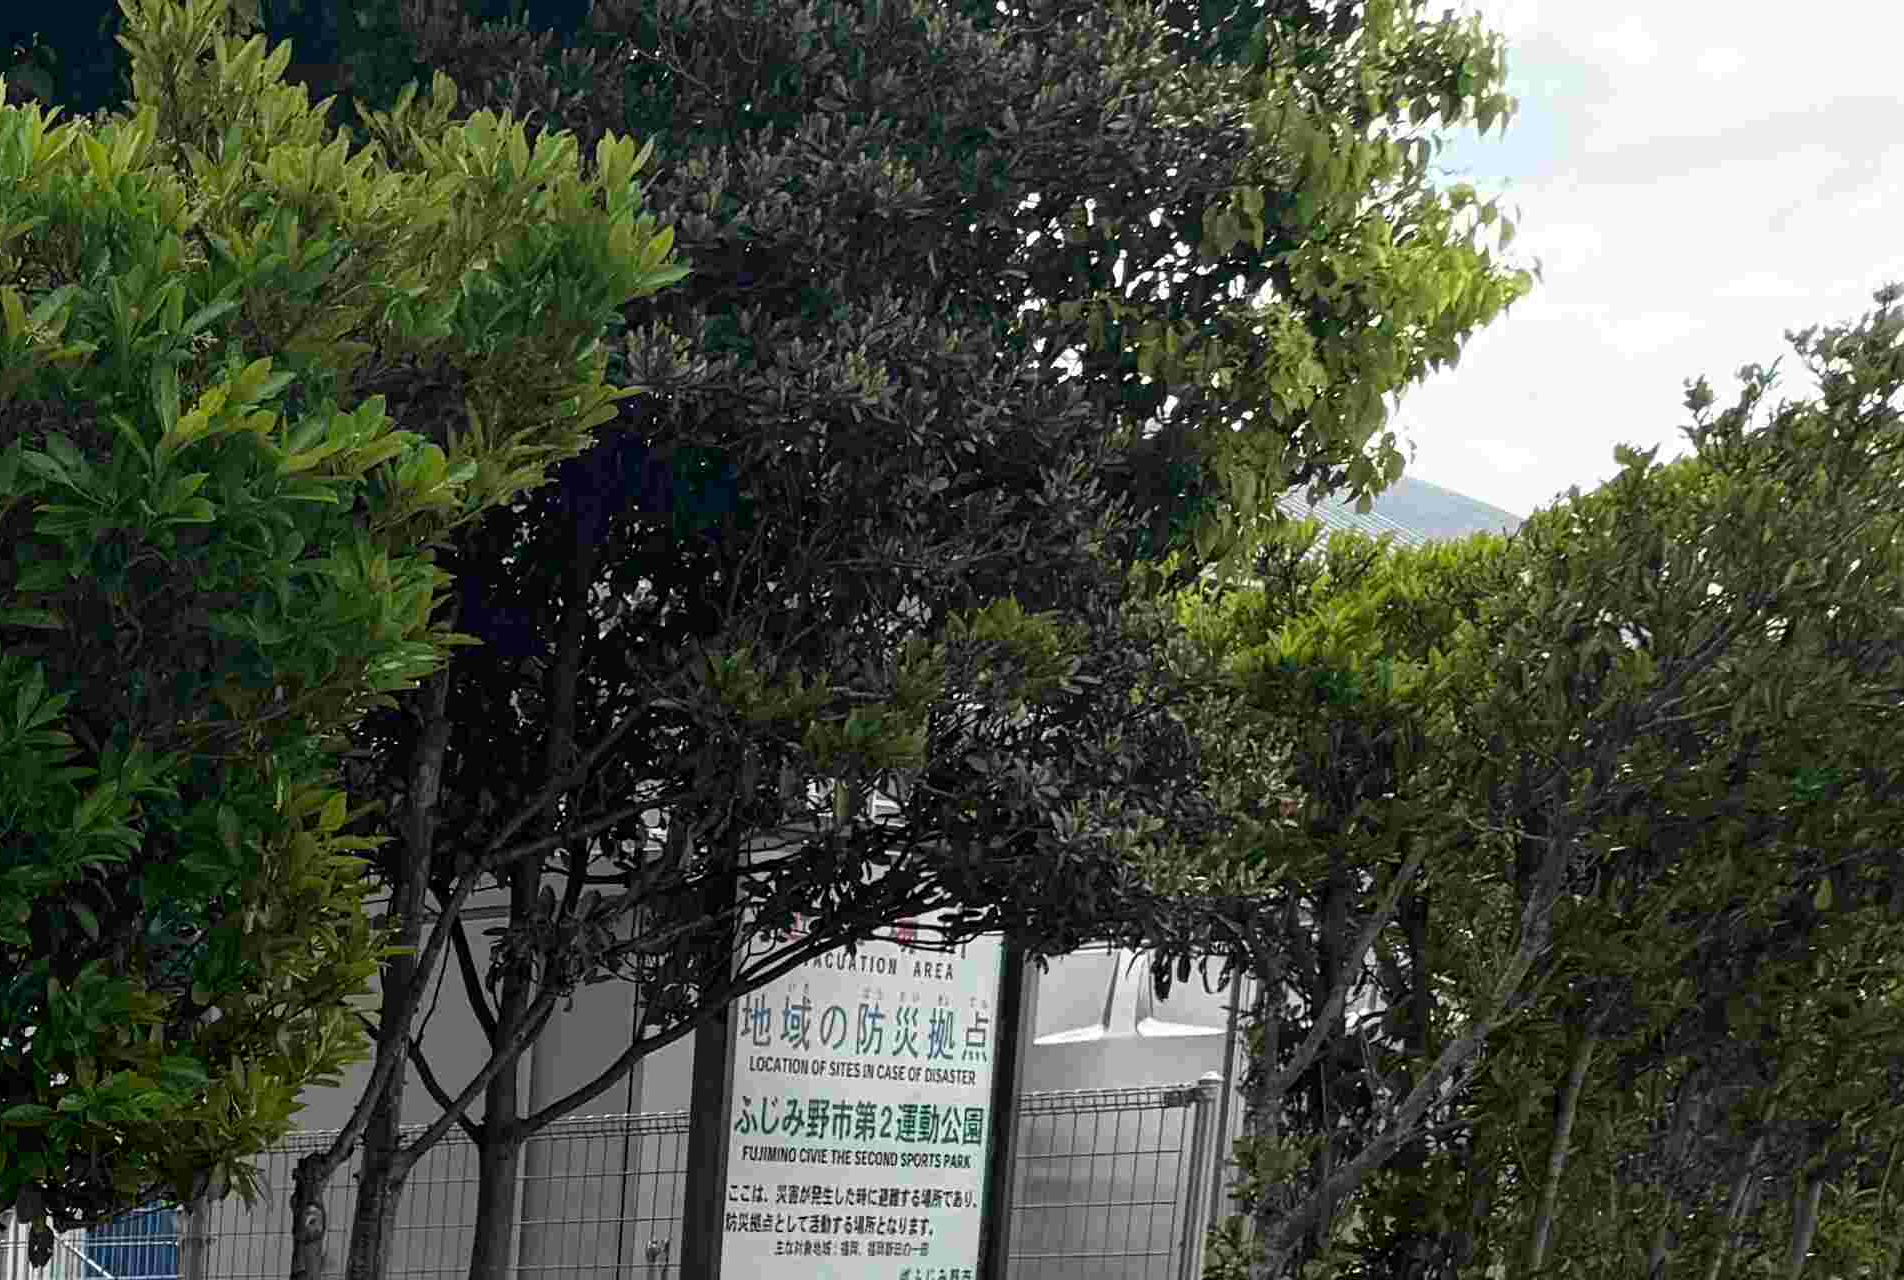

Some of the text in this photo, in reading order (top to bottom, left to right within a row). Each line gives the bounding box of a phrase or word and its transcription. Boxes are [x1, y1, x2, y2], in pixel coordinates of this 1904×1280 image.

[803, 952, 954, 980] ACUATION AREA
[740, 992, 989, 1063] 地域の防災拠点
[749, 1055, 976, 1086] LOCATION OF SITES IN CASE OF DISASTER
[734, 1095, 985, 1146] ふじみ野市第2運動公園
[742, 1145, 797, 1163] FUJIMINO
[830, 1149, 852, 1166] THE
[854, 1150, 897, 1167] SECOND
[900, 1152, 941, 1168] SPORTS
[943, 1154, 972, 1169] PARK
